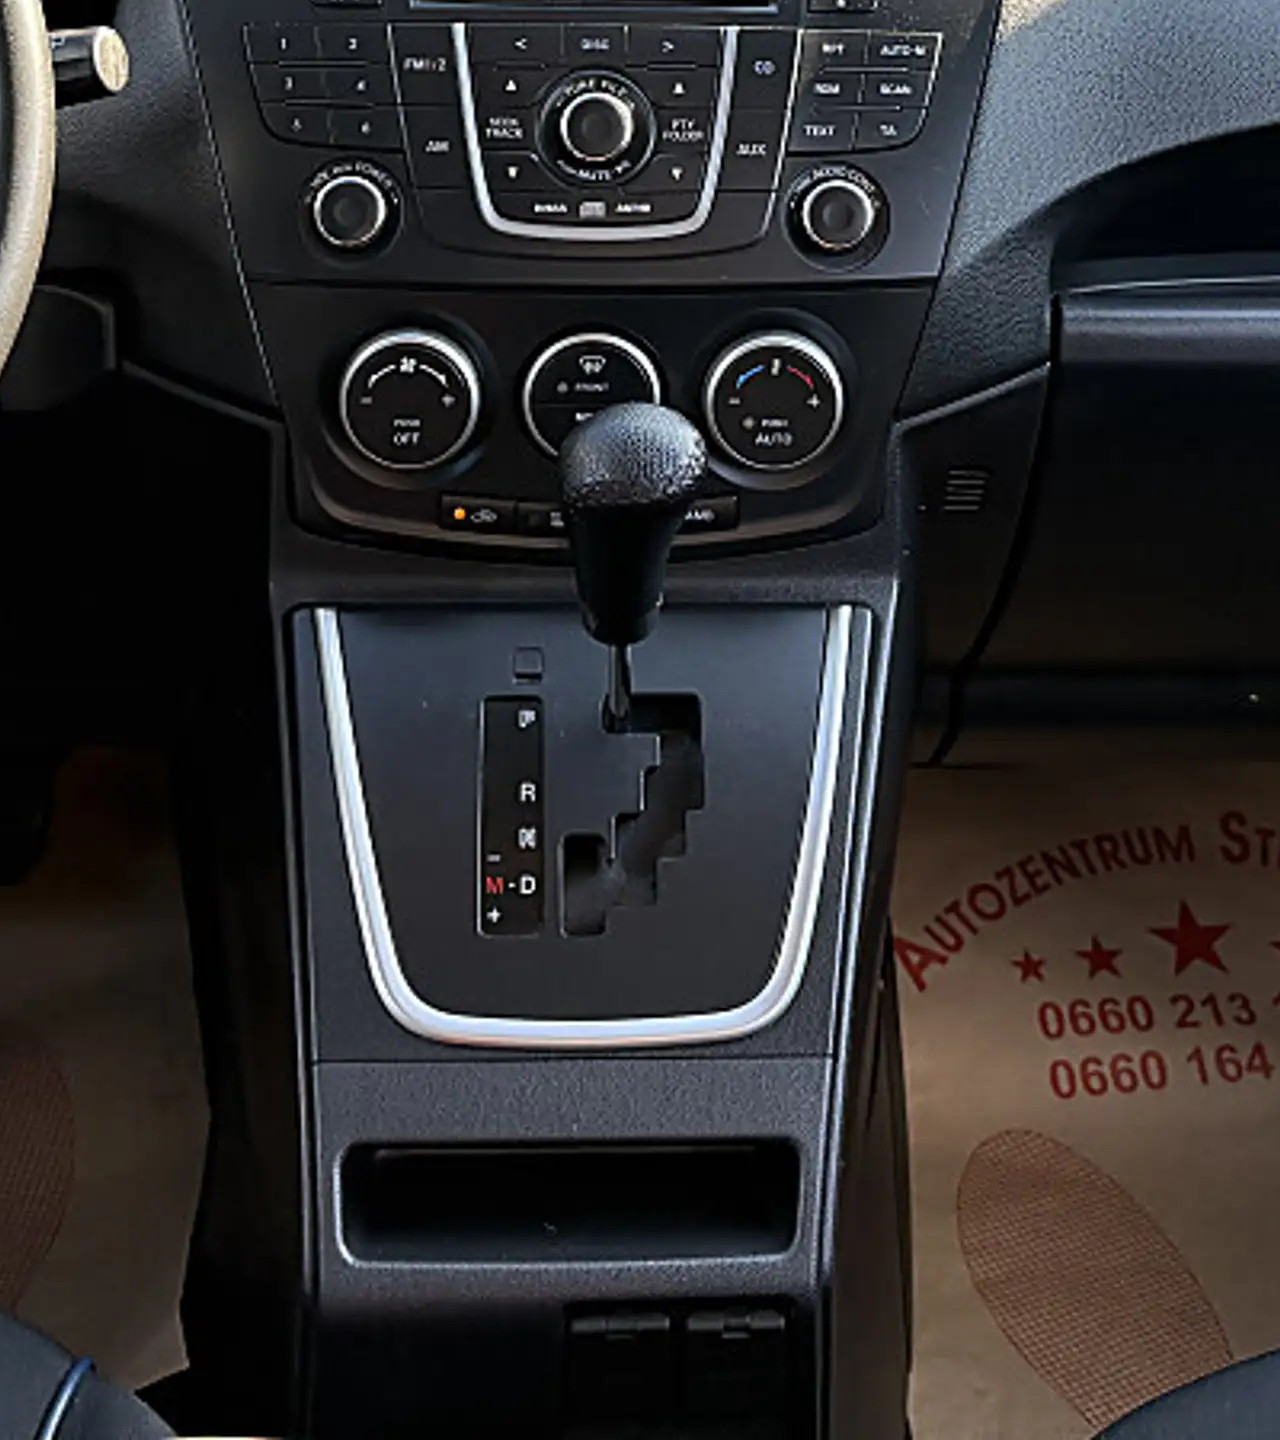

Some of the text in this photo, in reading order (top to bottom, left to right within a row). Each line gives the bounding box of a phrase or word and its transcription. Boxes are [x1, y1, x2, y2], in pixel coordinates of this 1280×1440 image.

[392, 430, 422, 447] OFF
[753, 431, 794, 448] AUTO
[519, 782, 537, 803] R
[891, 824, 1196, 992] AUTOZENTRUM
[1037, 994, 1154, 1041] 0660
[1169, 991, 1257, 1029] 213
[1050, 1049, 1169, 1100] 0660
[1188, 1043, 1275, 1086] 164
